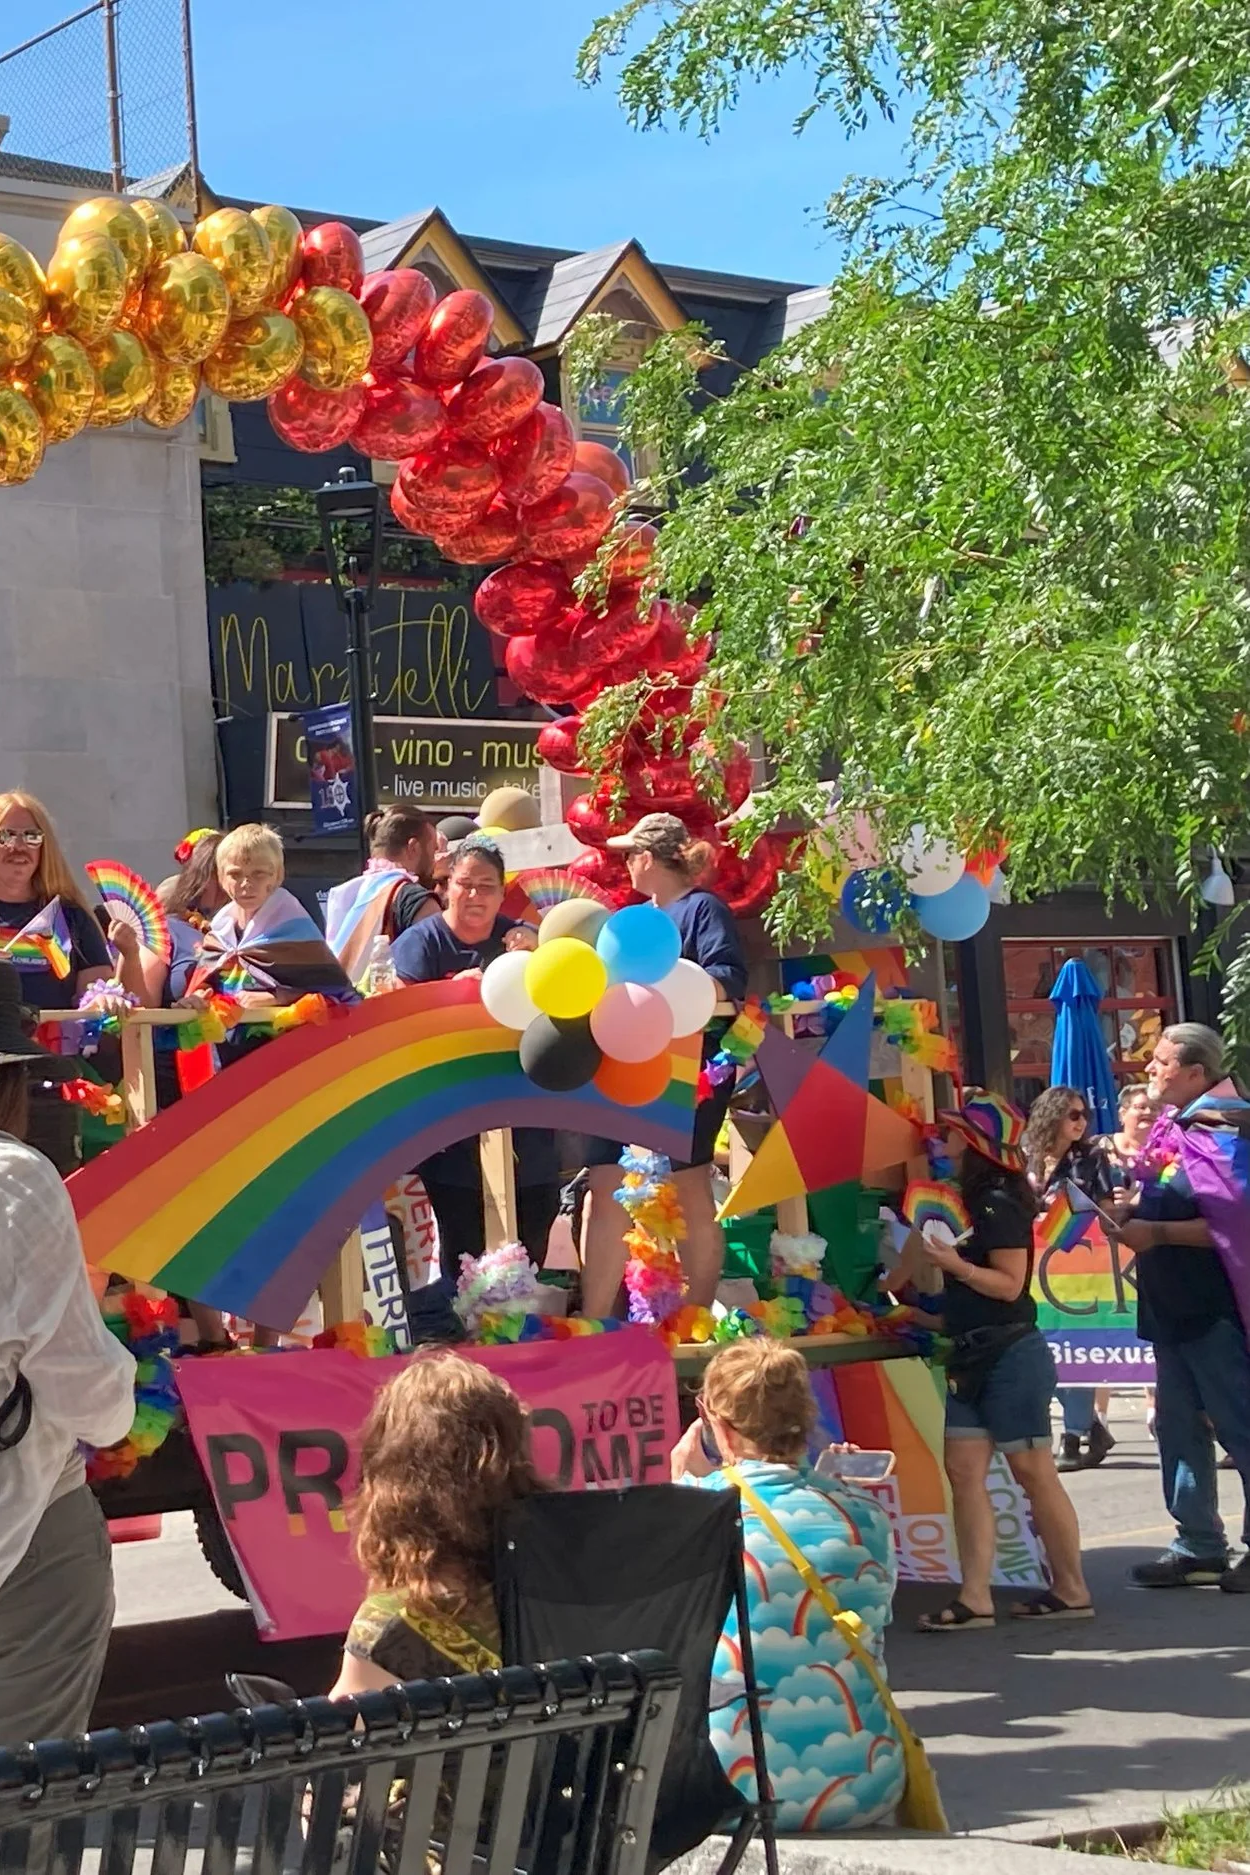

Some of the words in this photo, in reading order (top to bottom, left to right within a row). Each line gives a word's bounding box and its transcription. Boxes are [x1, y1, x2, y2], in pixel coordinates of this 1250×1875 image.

[392, 729, 454, 767] vino
[394, 774, 424, 798] live
[430, 776, 487, 799] music
[581, 1400, 618, 1433] TO
[626, 1394, 665, 1427] BE
